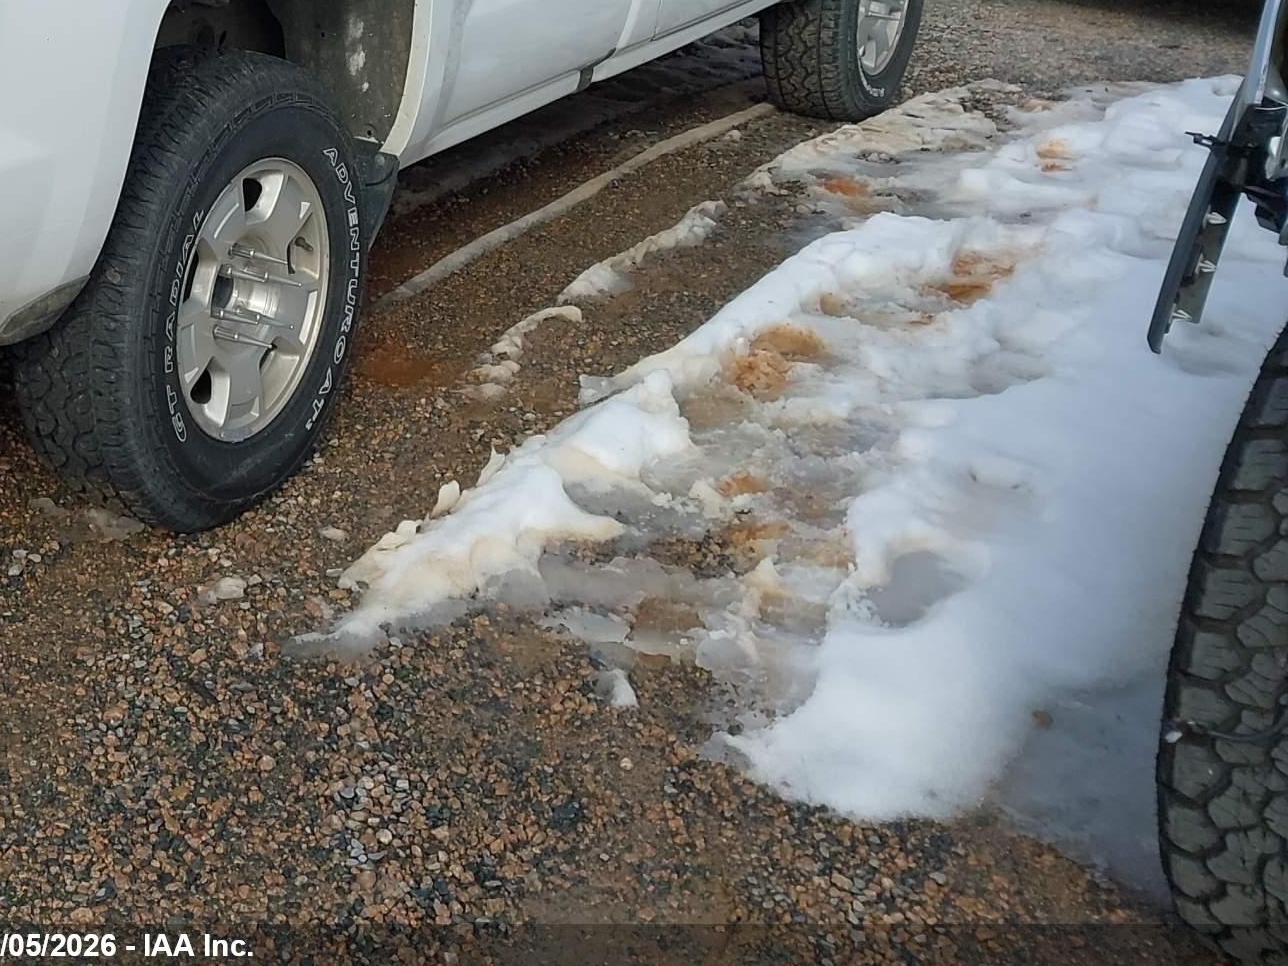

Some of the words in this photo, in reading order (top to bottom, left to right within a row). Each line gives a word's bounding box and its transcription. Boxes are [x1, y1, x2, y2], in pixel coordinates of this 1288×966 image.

[164, 210, 204, 373] RADIAL
[323, 147, 361, 364] ADVENTURO
[166, 385, 187, 443] GT
